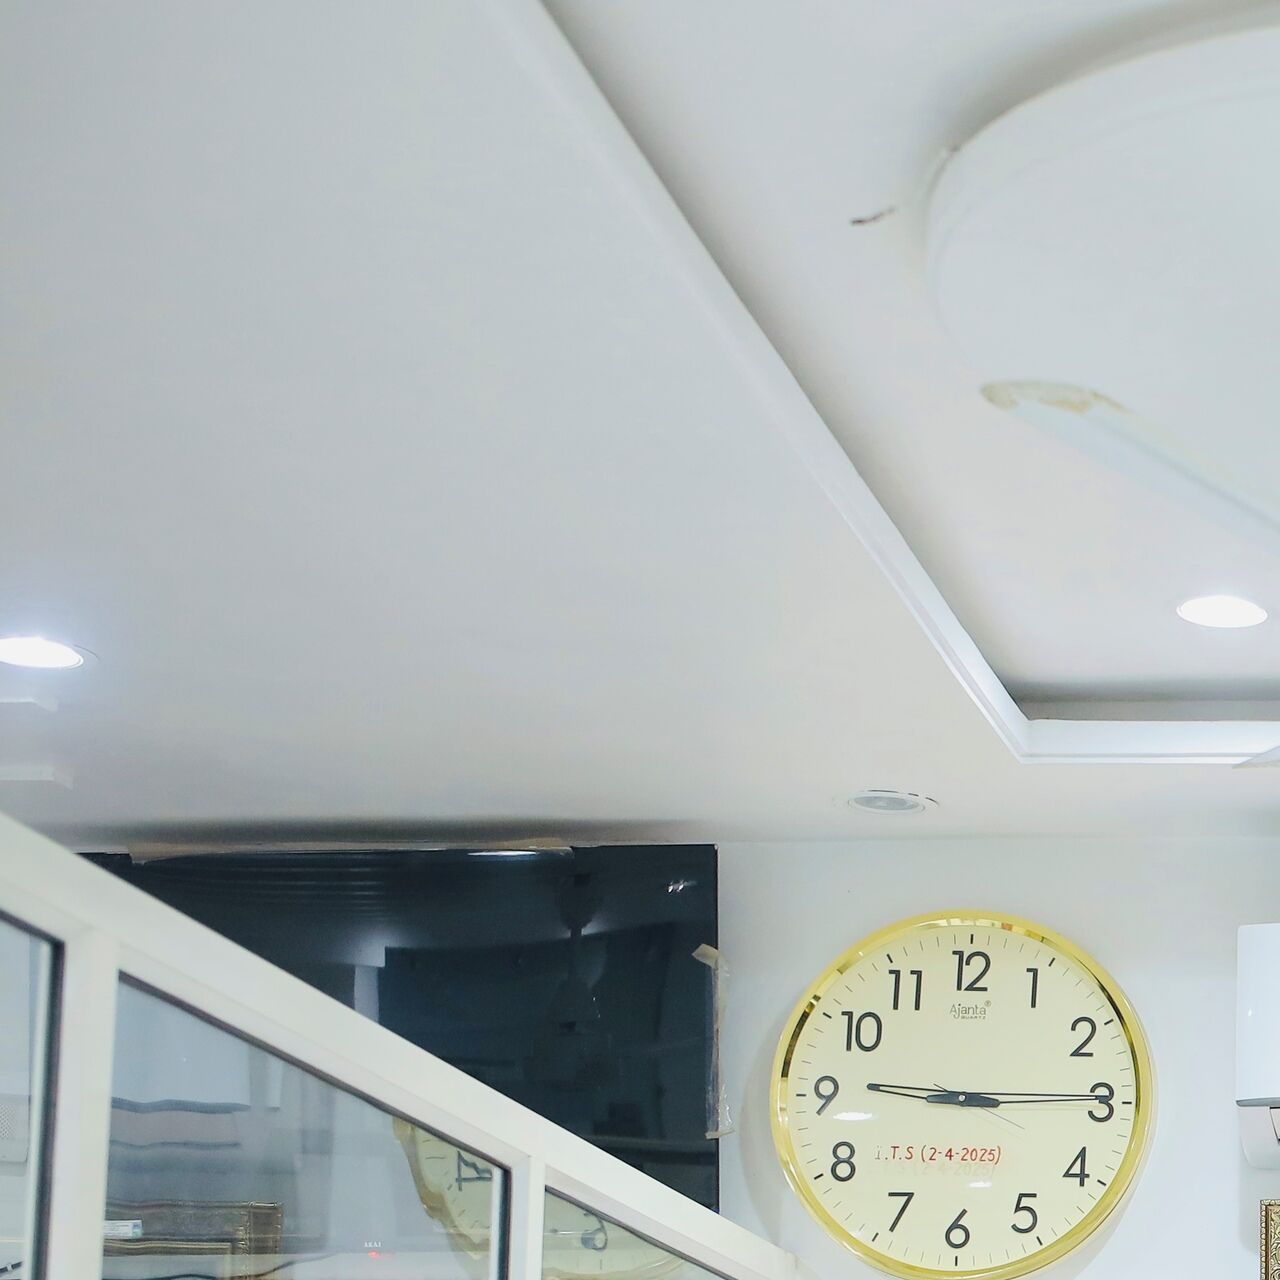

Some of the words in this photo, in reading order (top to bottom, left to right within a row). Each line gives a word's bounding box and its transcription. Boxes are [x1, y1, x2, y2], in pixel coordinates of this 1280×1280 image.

[889, 969, 922, 1010] 11
[952, 950, 991, 992] 12
[1026, 968, 1039, 1008] 1
[841, 1011, 882, 1052] 10
[1070, 1016, 1097, 1057] 2
[813, 1075, 839, 1116] 9
[1087, 1082, 1115, 1123] 3
[830, 1141, 856, 1182] 8
[921, 1145, 1001, 1165] (2-4-2025)
[1063, 1146, 1090, 1187] 4
[887, 1192, 915, 1232] 7
[945, 1209, 970, 1249] 6
[1011, 1193, 1038, 1234] 5
